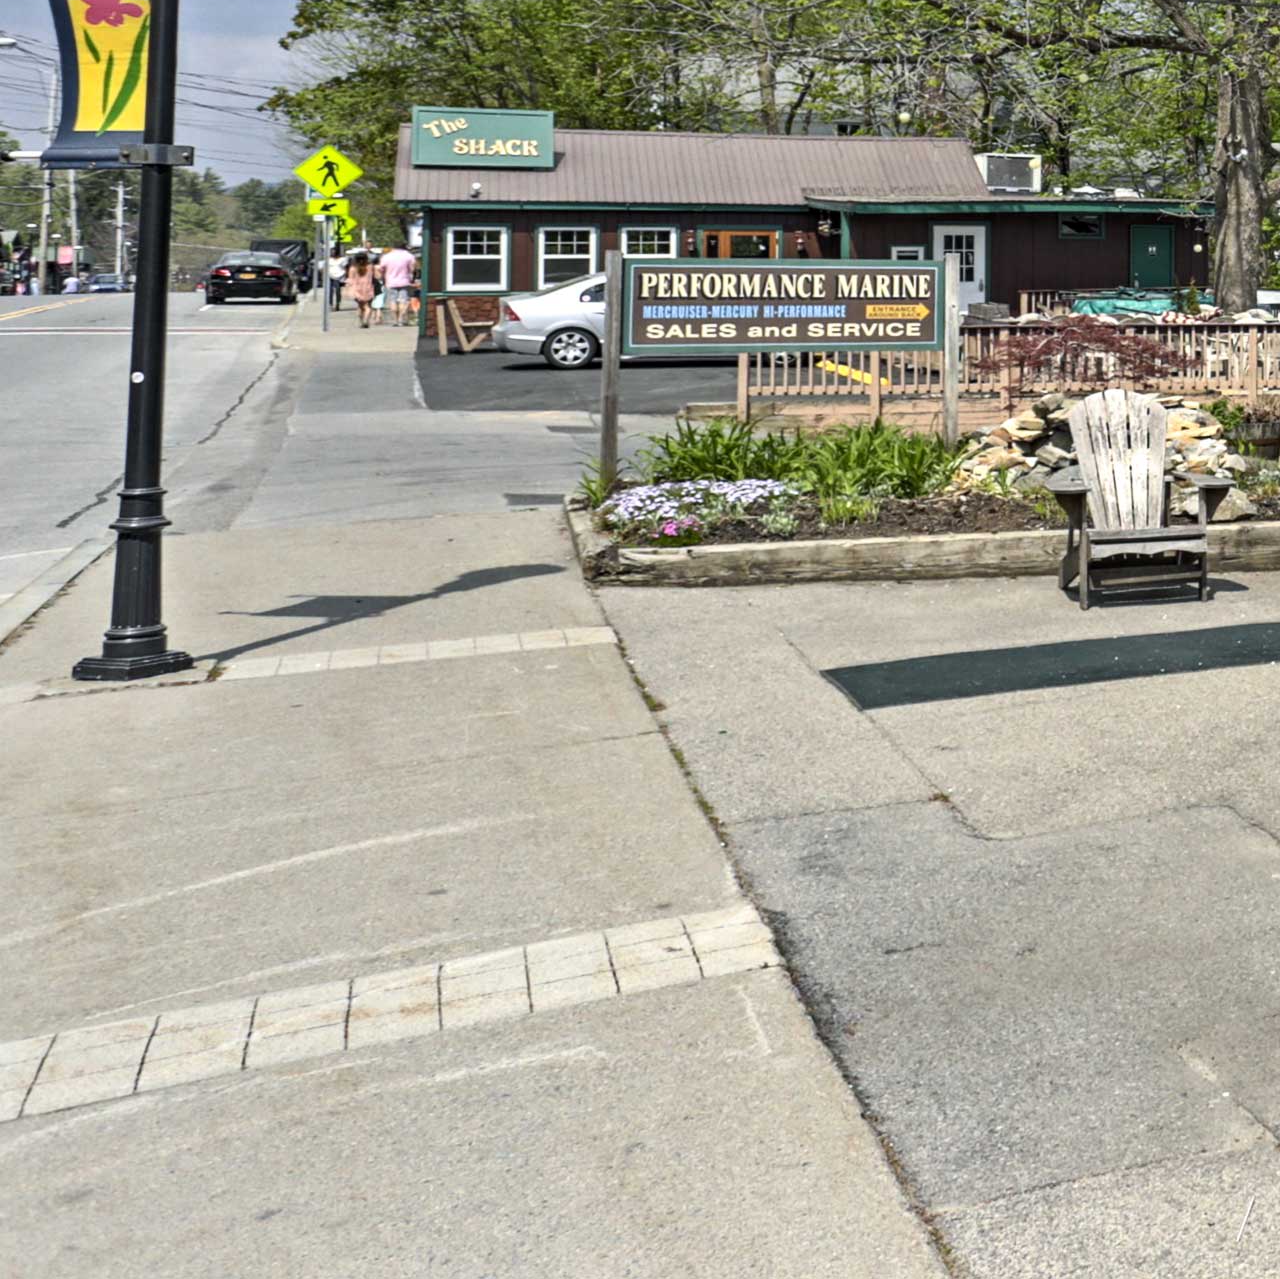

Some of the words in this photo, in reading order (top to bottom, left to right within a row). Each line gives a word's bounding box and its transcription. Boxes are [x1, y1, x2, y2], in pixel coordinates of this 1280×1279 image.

[422, 117, 469, 138] The
[453, 138, 539, 156] SHACK
[640, 272, 826, 299] PERFORMANCE
[837, 274, 931, 299] MARINE
[643, 305, 759, 319] MERCRUISER-MERCURY
[763, 305, 846, 319] HI-PERFORMANCE
[646, 323, 737, 338] SALES
[747, 323, 797, 337] and
[807, 322, 921, 337] SERVICE
